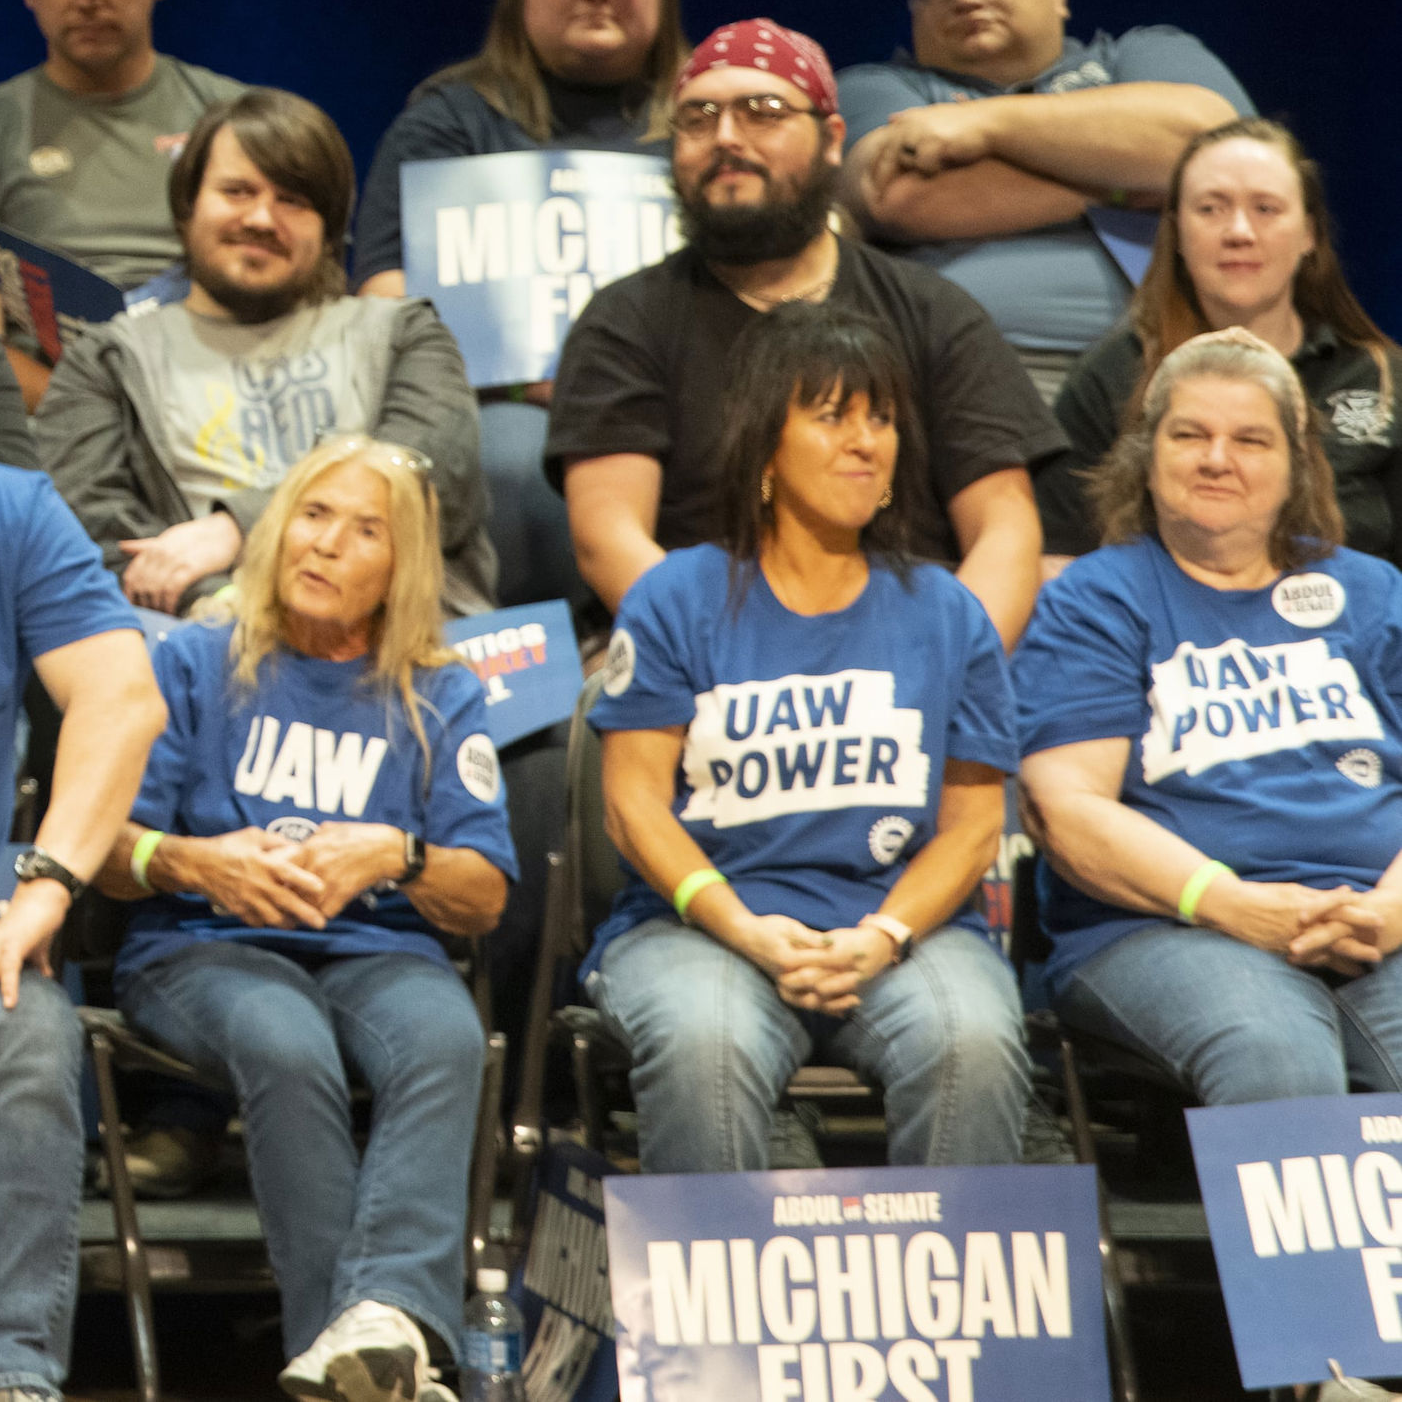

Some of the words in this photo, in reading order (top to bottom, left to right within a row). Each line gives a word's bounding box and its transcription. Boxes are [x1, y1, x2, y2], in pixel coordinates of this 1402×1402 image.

[725, 680, 854, 742] UAW
[1170, 683, 1355, 753] POWER
[234, 714, 389, 818] UAW
[709, 735, 900, 799] POWER
[773, 1194, 844, 1227] ABDUL
[863, 1192, 943, 1224] SENATE
[646, 1230, 1073, 1347] MICHIGAN
